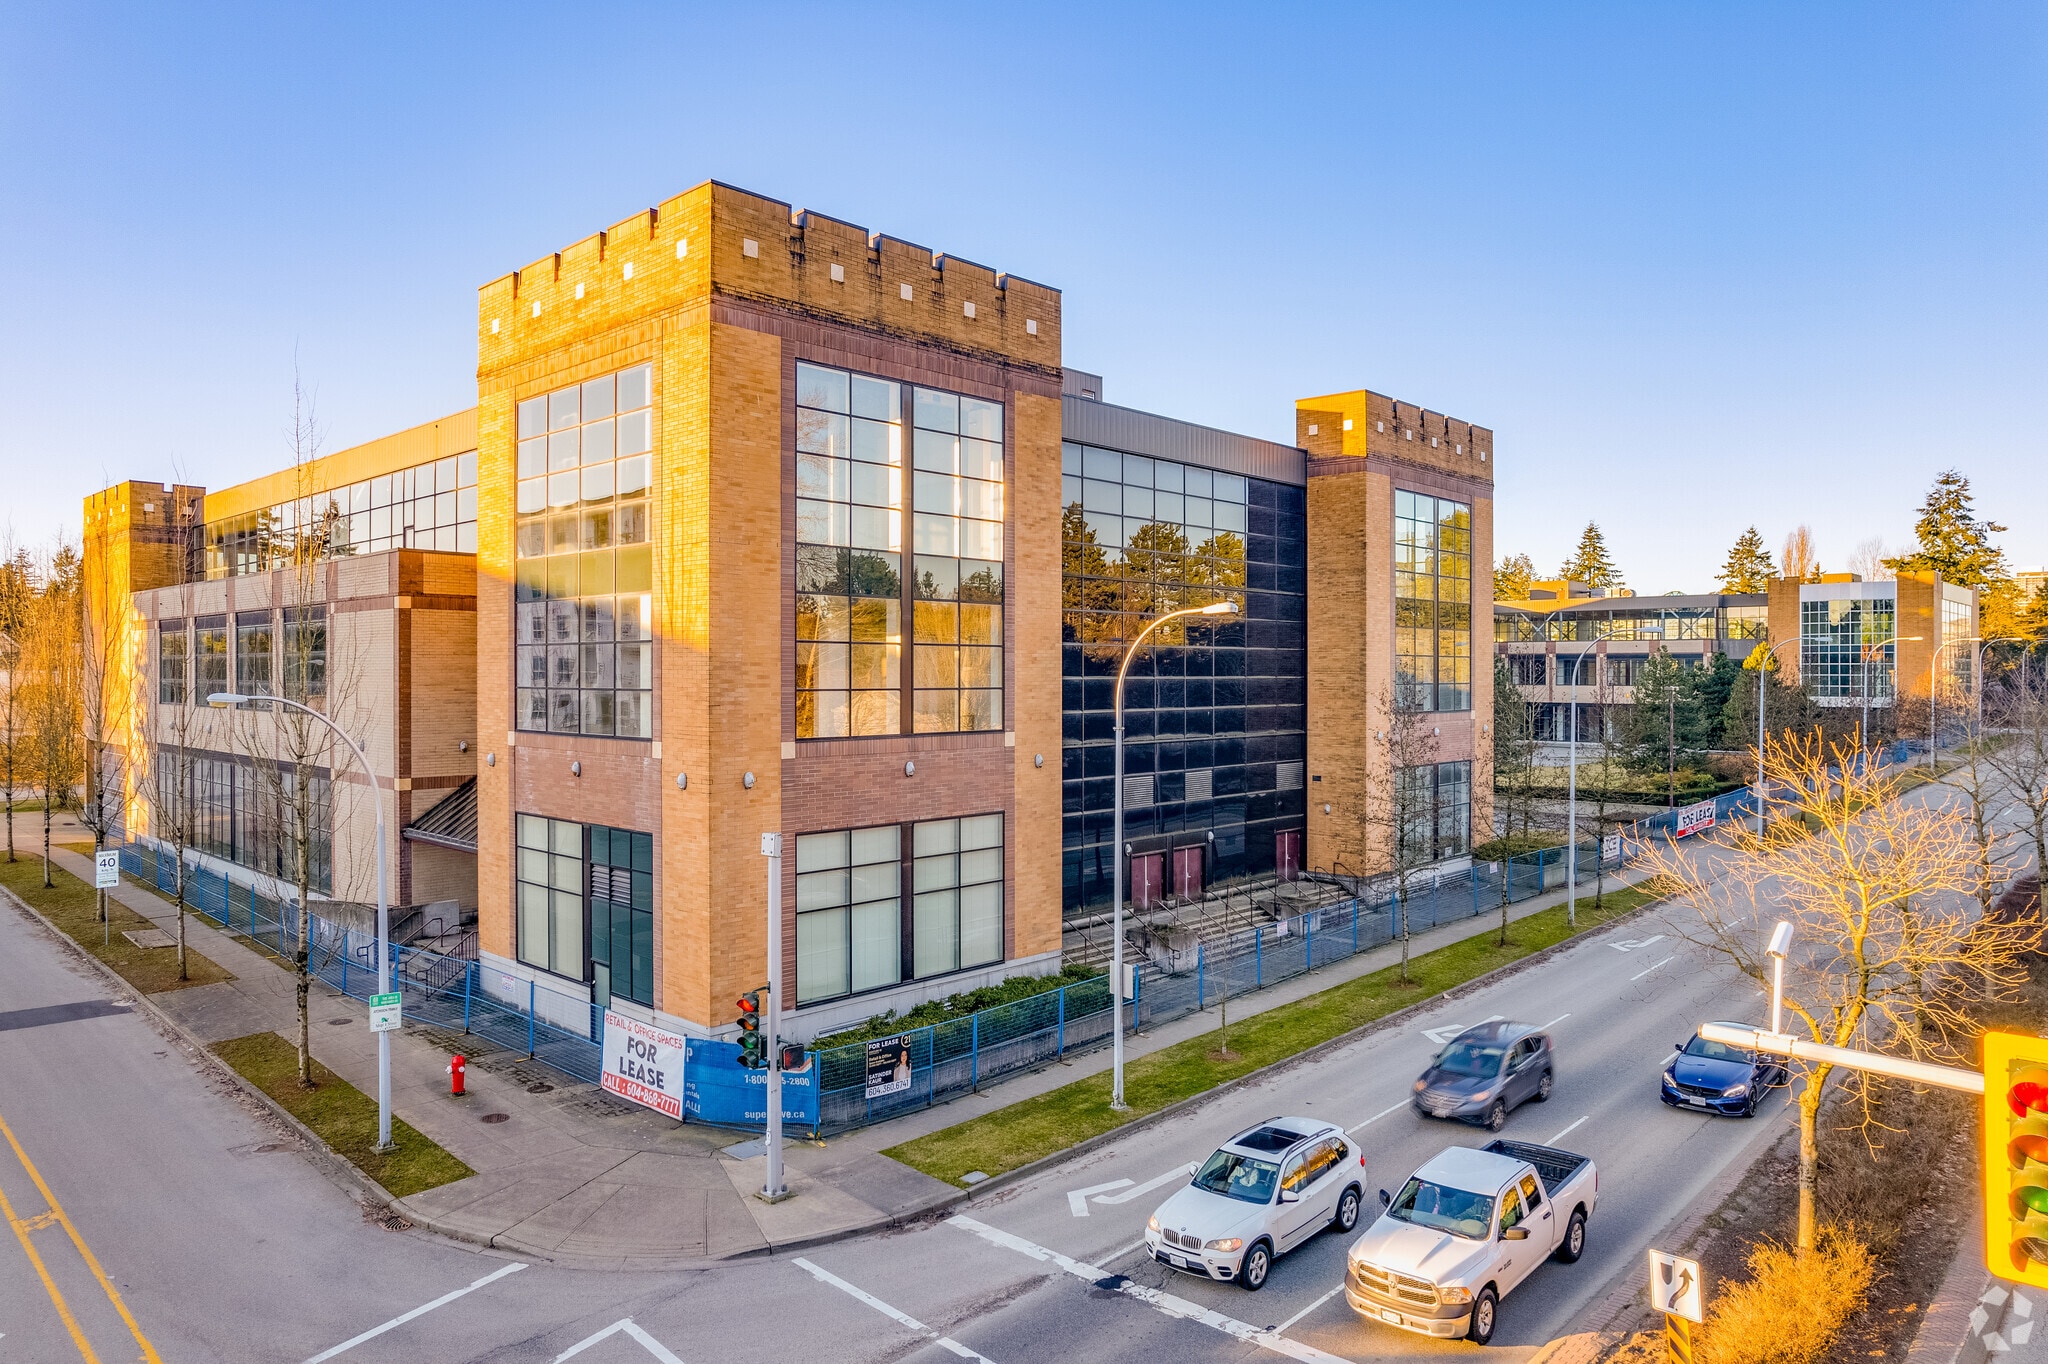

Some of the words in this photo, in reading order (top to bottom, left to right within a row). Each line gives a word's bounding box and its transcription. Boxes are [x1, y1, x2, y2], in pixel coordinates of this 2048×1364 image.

[100, 857, 115, 867] 40
[605, 1013, 626, 1029] RETAIL
[627, 1021, 632, 1031] &
[634, 1023, 656, 1041] OFFICE
[657, 1033, 683, 1049] SPACES
[627, 1036, 657, 1064] FOR
[882, 1038, 899, 1047] LEASE
[619, 1056, 664, 1090] LEASE
[869, 1070, 892, 1079] SATINDER
[603, 1073, 620, 1091] CALL
[626, 1082, 679, 1114] 604-868-7777
[744, 1110, 805, 1120] supeve.ca
